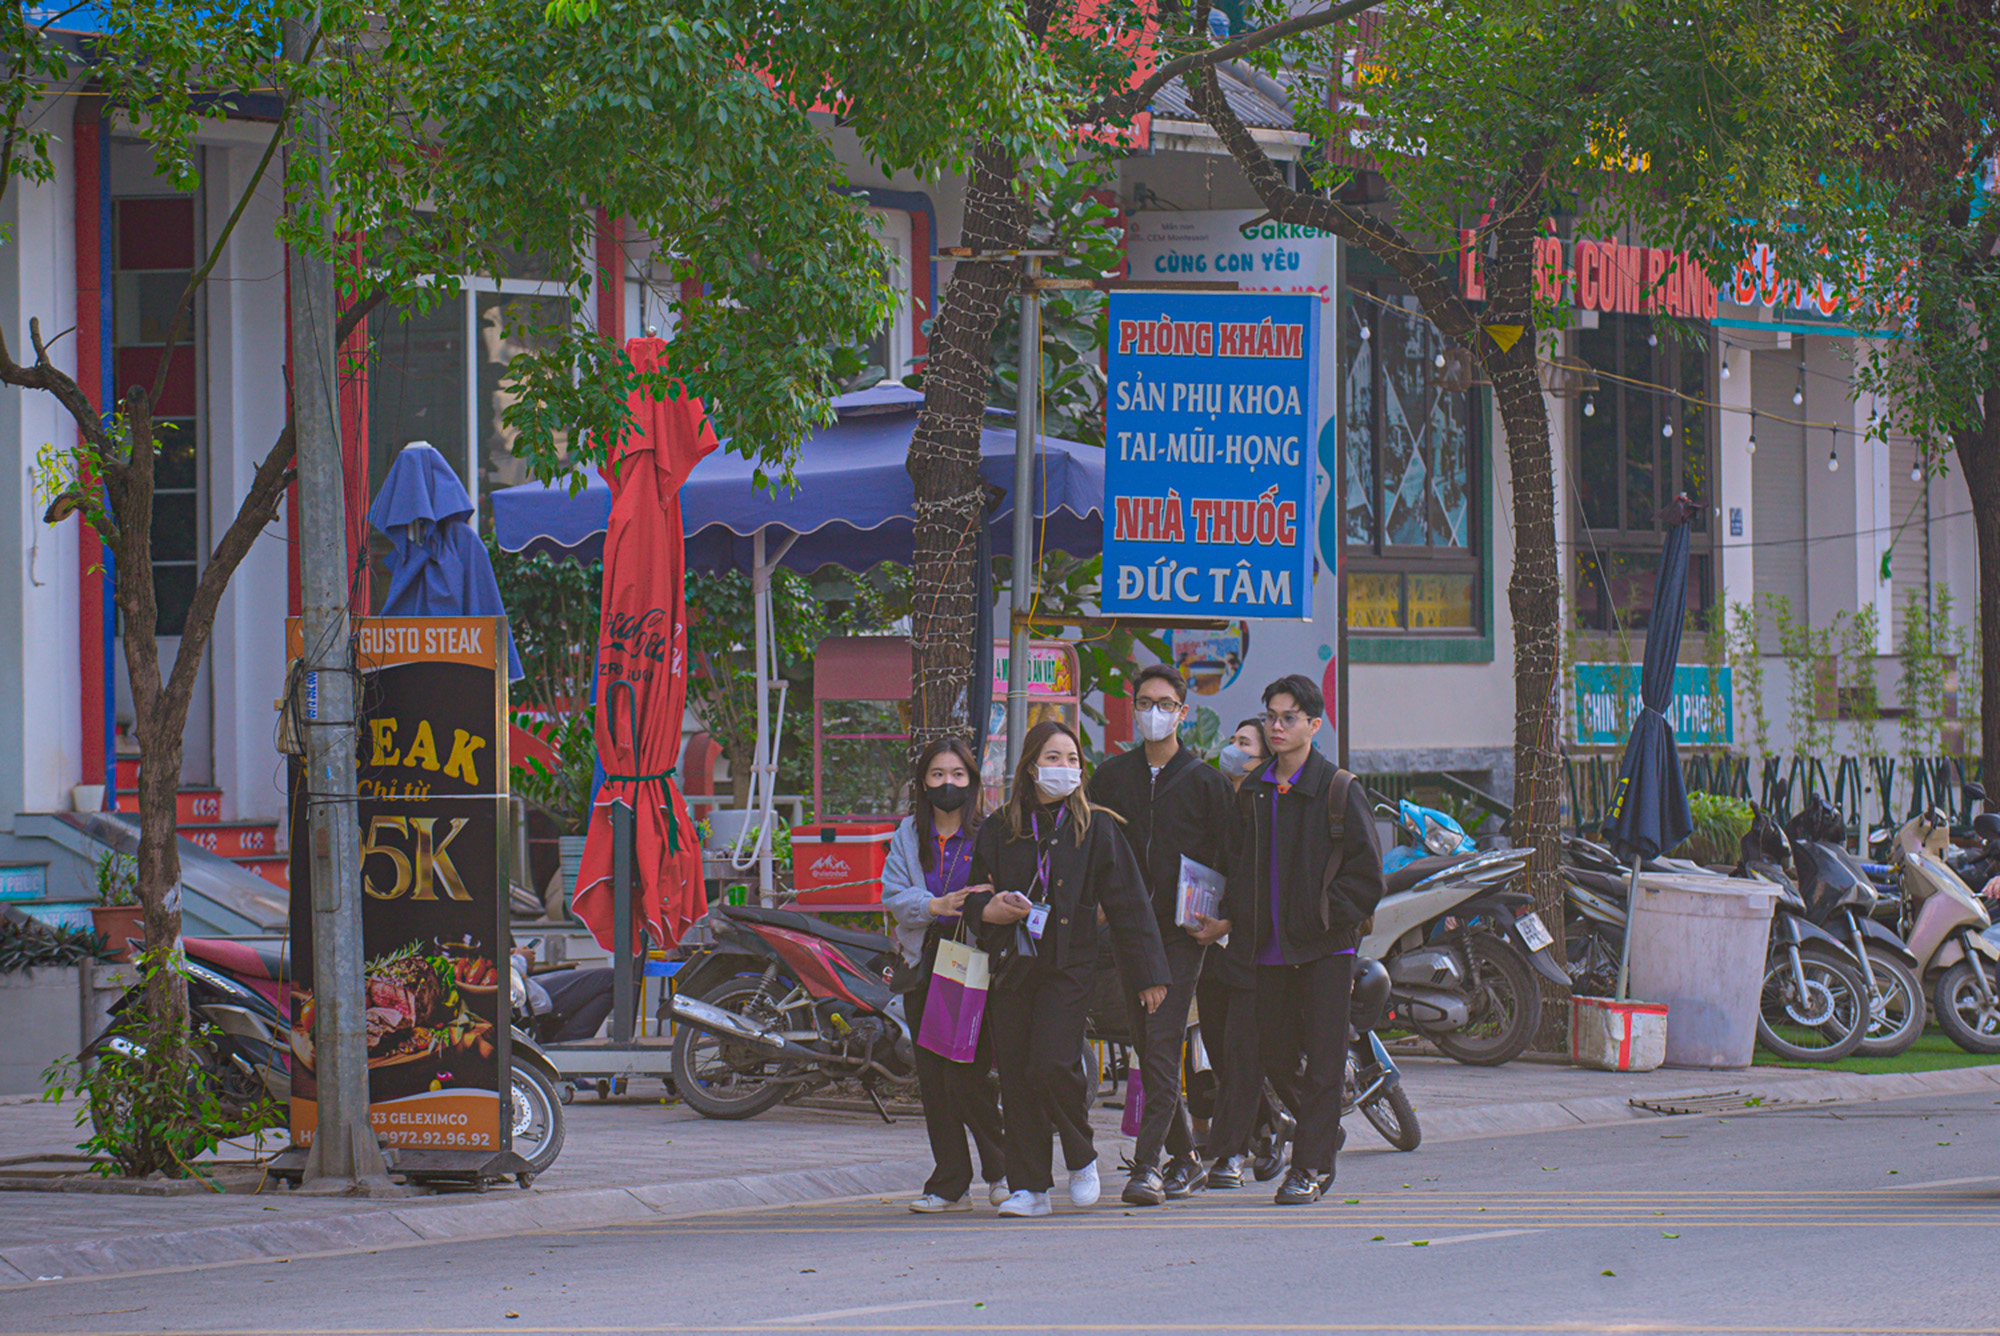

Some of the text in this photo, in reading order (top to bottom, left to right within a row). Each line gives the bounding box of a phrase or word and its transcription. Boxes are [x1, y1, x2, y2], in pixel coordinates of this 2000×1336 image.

[1155, 247, 1300, 273] CÙNG CON YÊU
[1577, 236, 1641, 314] CƠM
[1118, 313, 1303, 359] PHÒNG KHÁM
[1116, 371, 1302, 421] SẢN PHỤ KHOA
[1117, 427, 1300, 473] TAI-MŨI-HỌNG
[1114, 483, 1296, 547] NHÀ THUỐC
[1117, 556, 1293, 606] ĐỨC TÂM
[360, 627, 483, 655] GUSTO STEAK
[356, 717, 487, 786] EAK
[357, 779, 431, 802] Chỉ từ
[359, 815, 474, 901] 5K
[389, 1112, 468, 1126] GELEXIMCO
